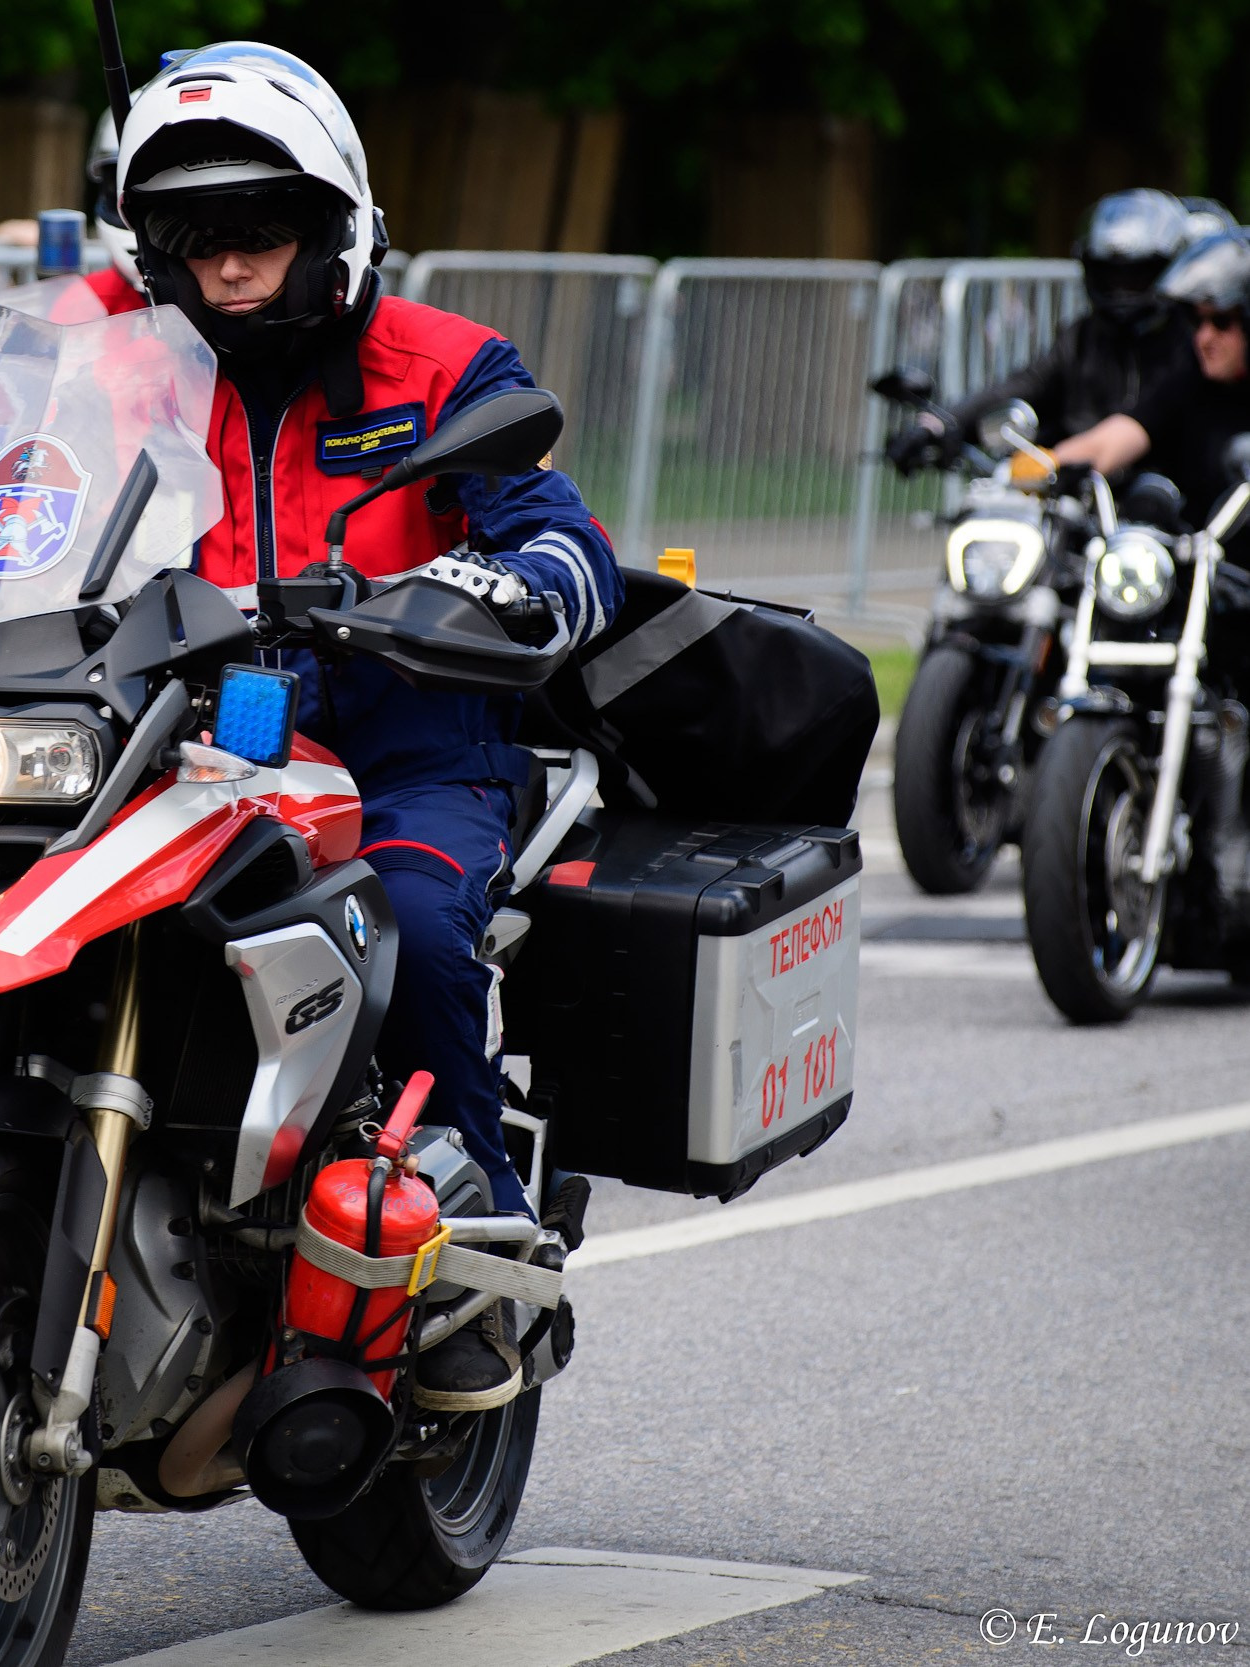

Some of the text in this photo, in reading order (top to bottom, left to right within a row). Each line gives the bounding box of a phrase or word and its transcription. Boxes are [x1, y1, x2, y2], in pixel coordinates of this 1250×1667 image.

[325, 421, 413, 447] ПОЖАРНО-СПАСАТЕЛЬНЫЙ
[361, 439, 380, 451] ЦЕНТР
[770, 899, 844, 977] ТЕЛЕФОН
[285, 977, 345, 1034] GS
[762, 1027, 837, 1128] 01 101
